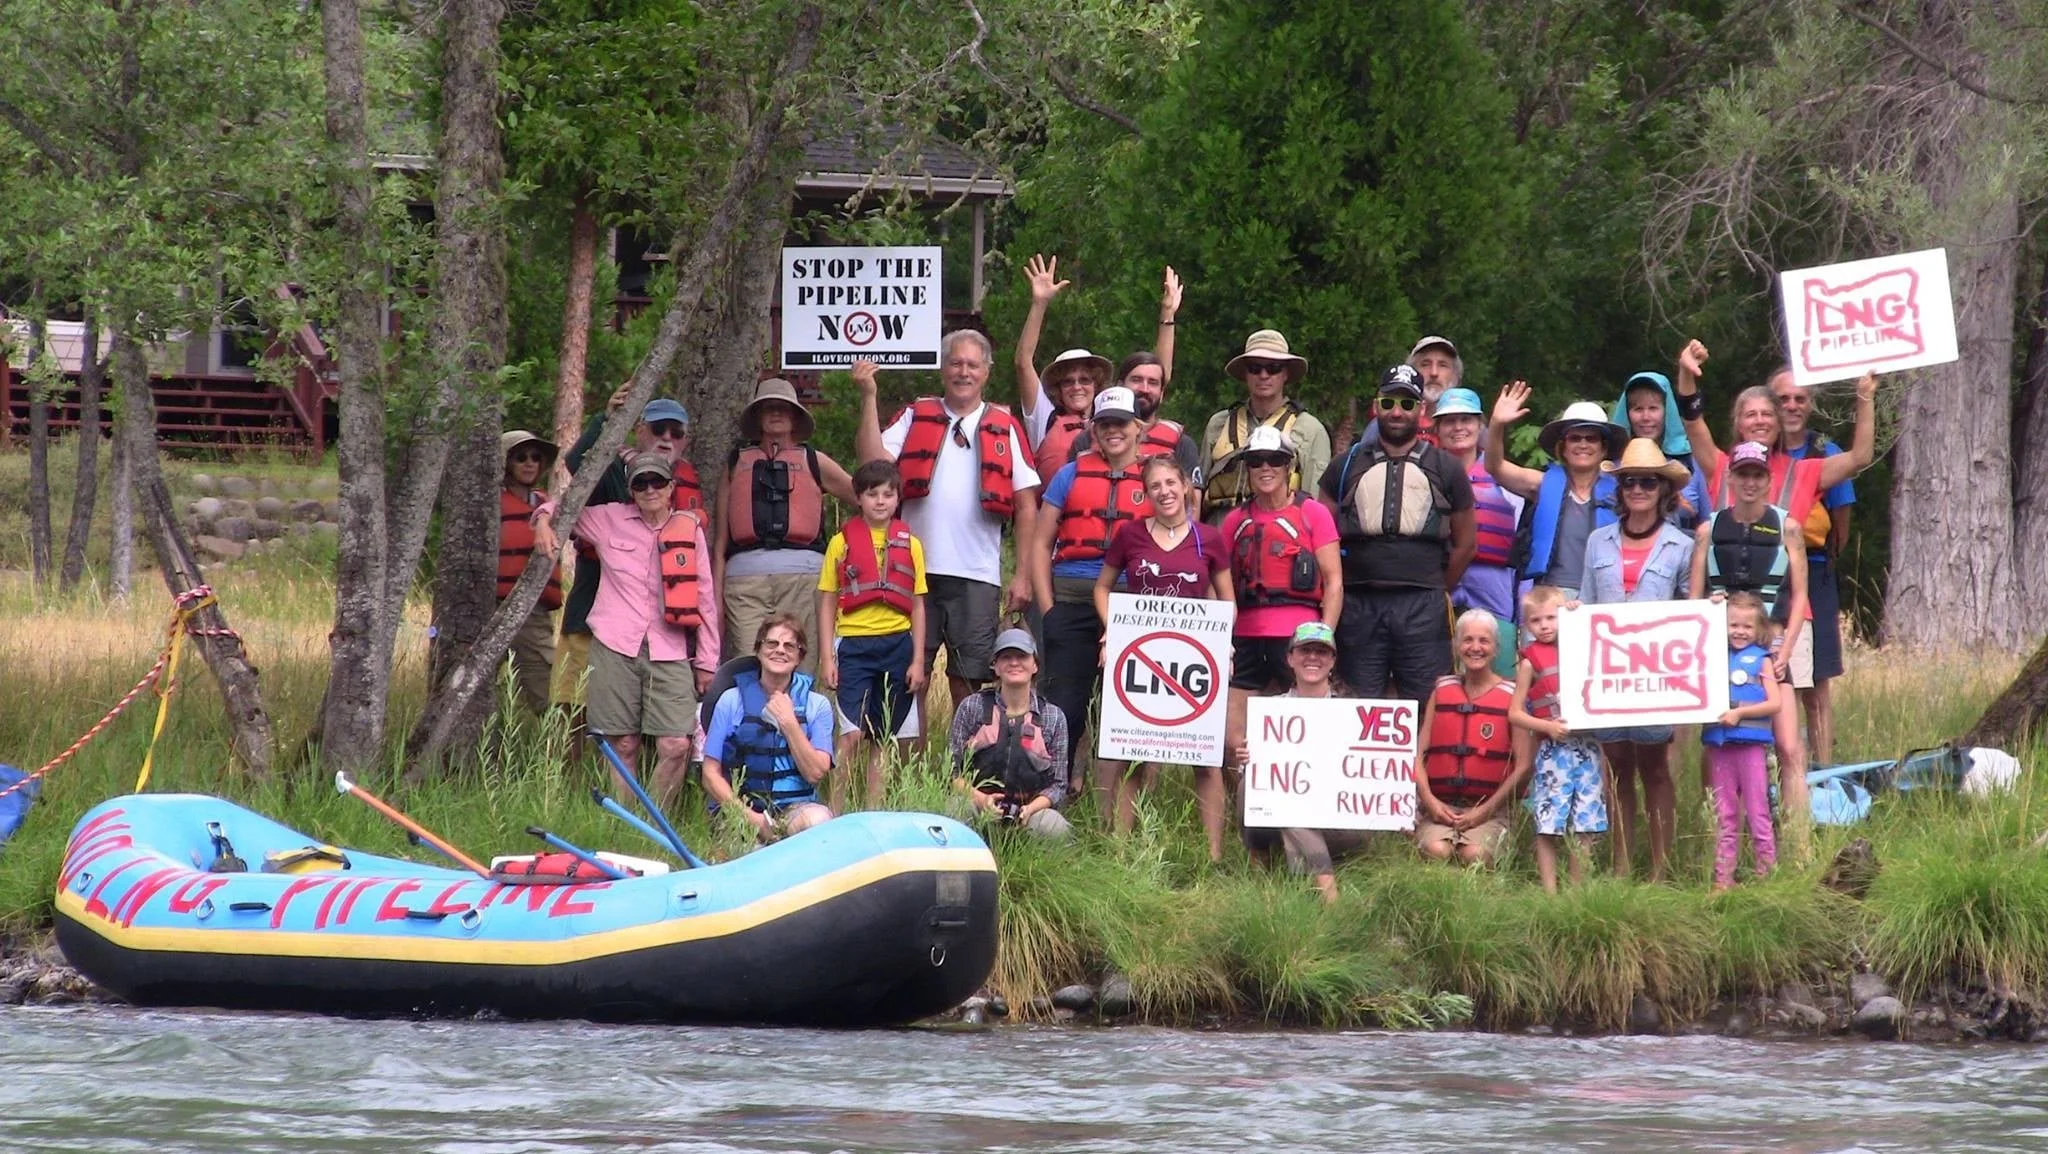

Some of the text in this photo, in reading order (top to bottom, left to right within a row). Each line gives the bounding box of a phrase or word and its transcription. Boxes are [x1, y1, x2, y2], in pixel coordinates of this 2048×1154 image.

[792, 258, 932, 279] STOP THE
[798, 286, 927, 306] PIPELINE
[1816, 293, 1906, 334] LNG
[812, 354, 910, 364] ILOVEOREGON.ORG
[1135, 599, 1207, 616] OREGON
[1112, 613, 1228, 633] DESERVES BETTER
[1601, 639, 1693, 675] LNG
[1125, 659, 1209, 699] LNG
[1263, 715, 1306, 744] NO
[1356, 706, 1412, 746] YES
[1121, 747, 1202, 761] 1-866-211-7335
[1252, 760, 1311, 795] LNG
[1341, 755, 1416, 783] CLEAN
[1337, 791, 1415, 818] RIVERS
